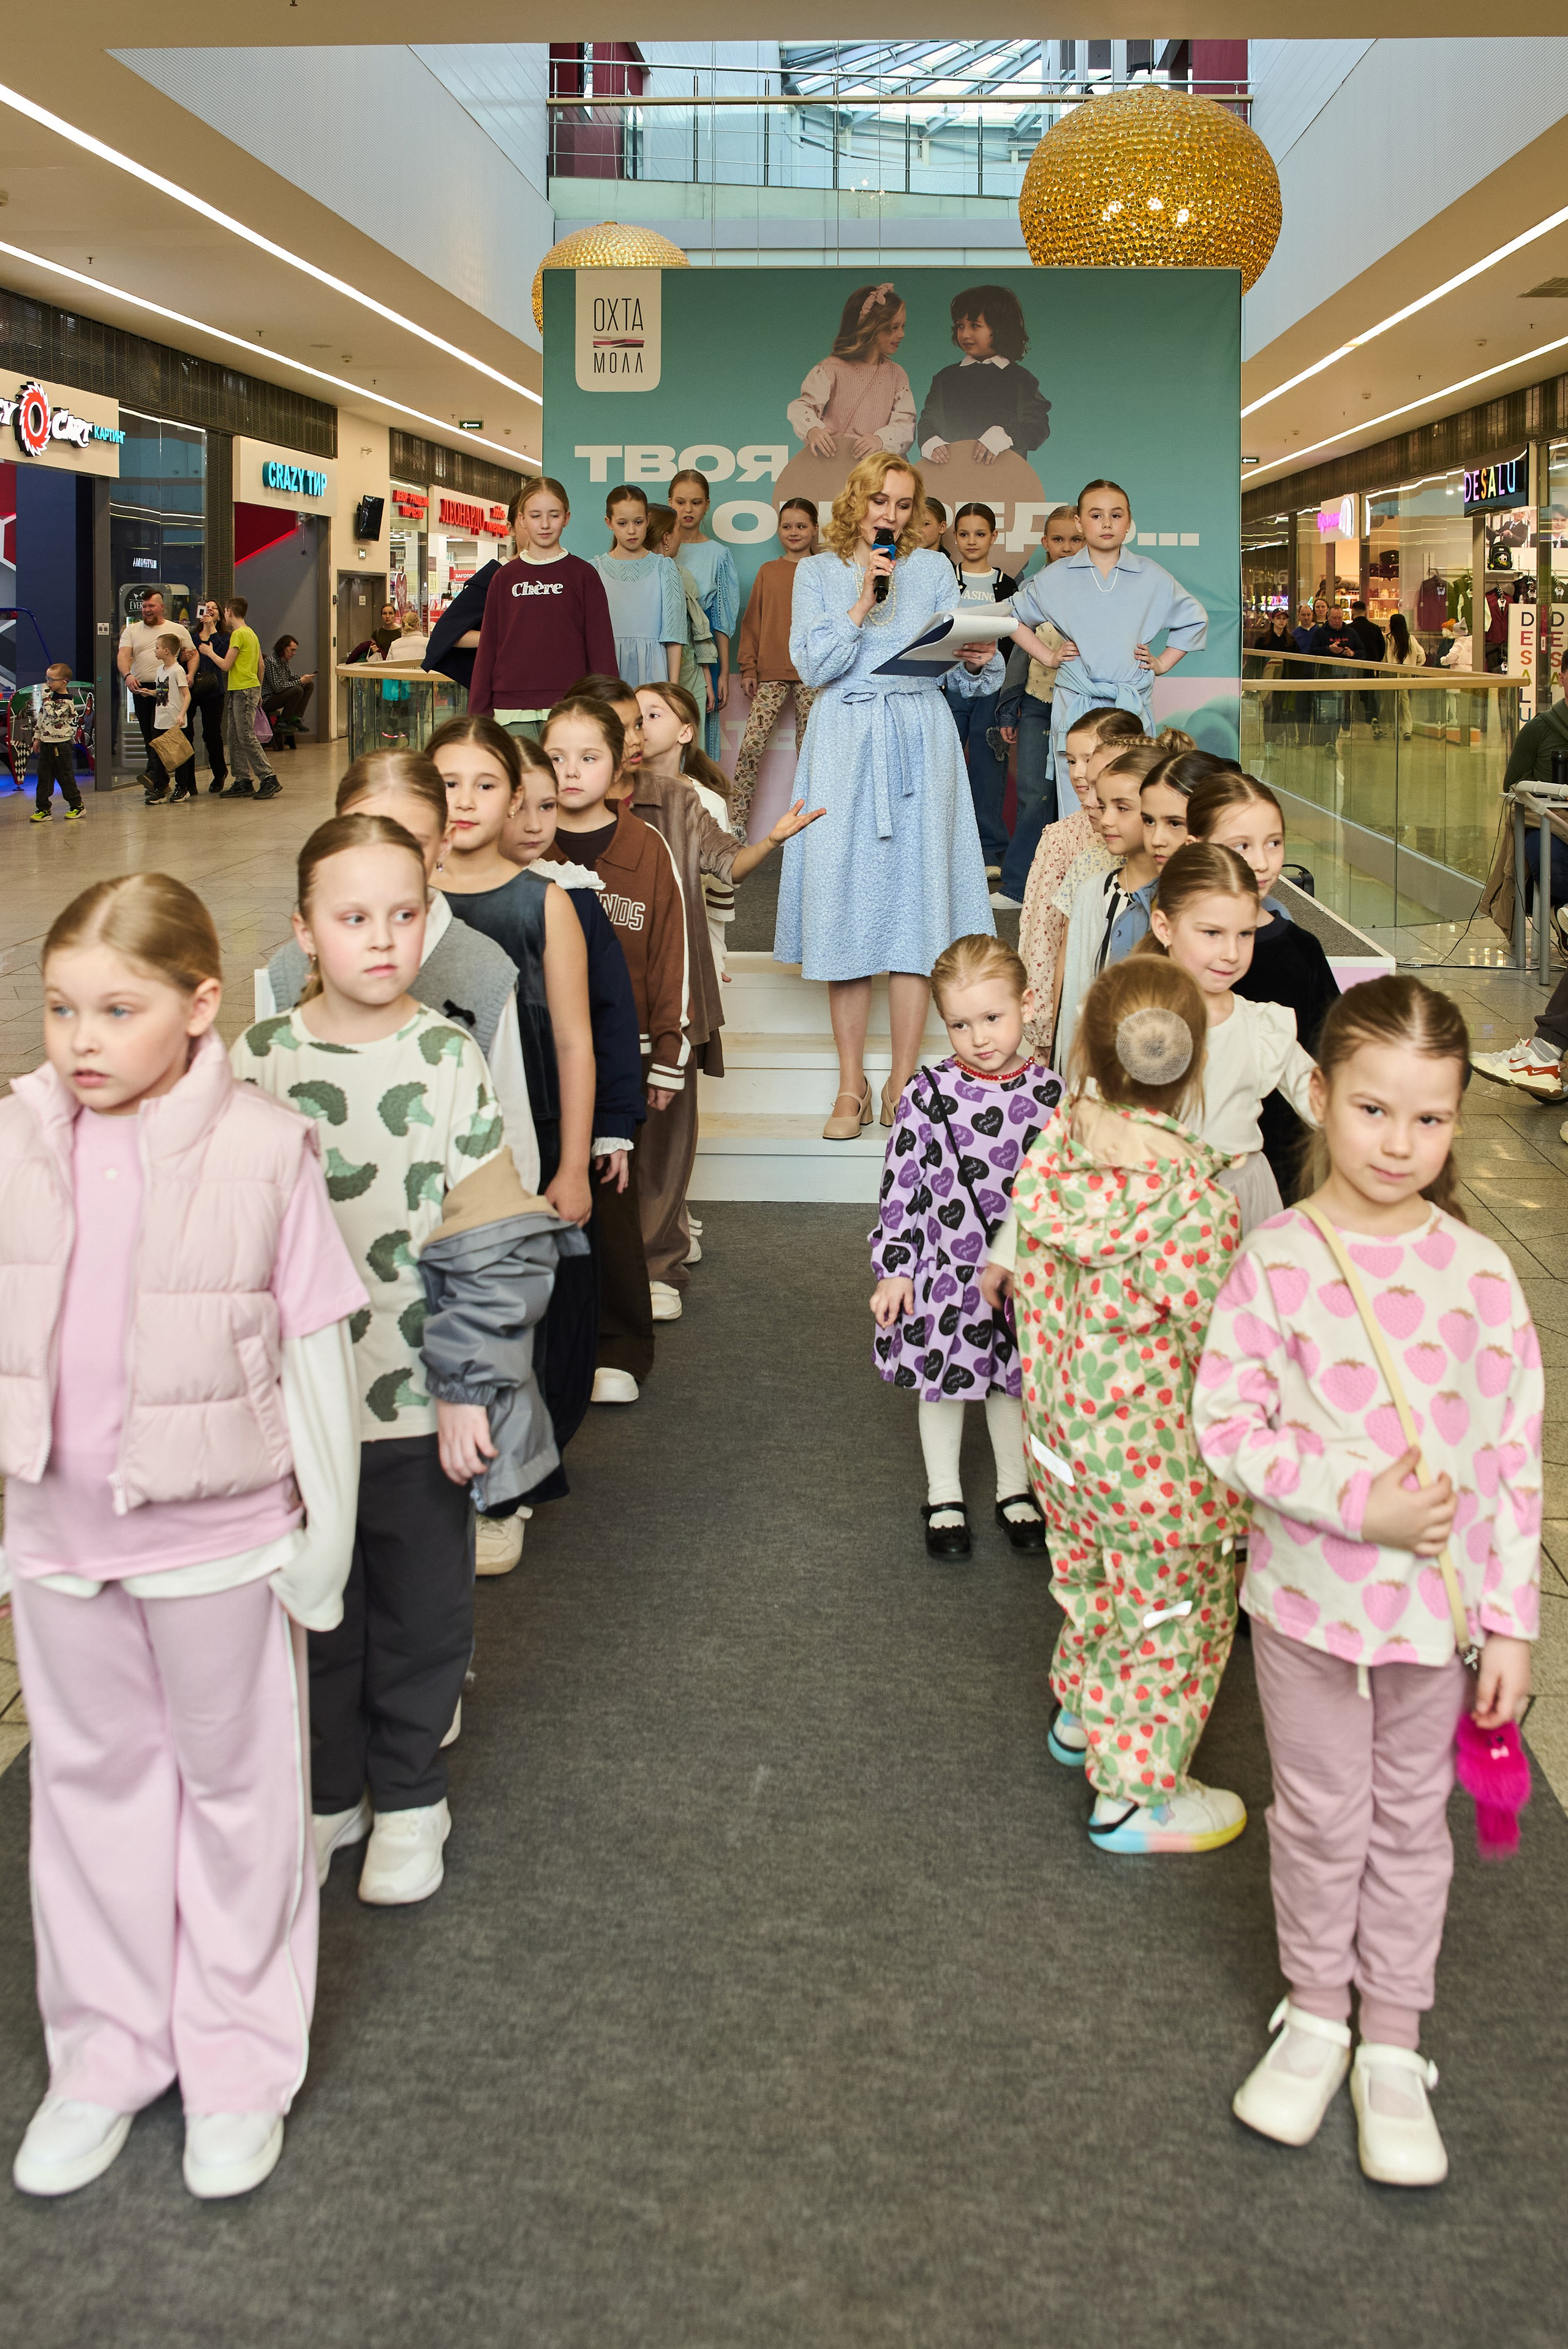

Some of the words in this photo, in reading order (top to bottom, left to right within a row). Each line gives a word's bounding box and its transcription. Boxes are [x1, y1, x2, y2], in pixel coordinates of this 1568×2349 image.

[594, 298, 643, 331] ОХТА
[594, 352, 643, 373] МОЛЛ
[94, 426, 126, 444] КАРТИНГ
[268, 461, 305, 492] CRAZY
[307, 470, 328, 497] ТИР
[575, 445, 789, 483] ТВОЯ
[1464, 461, 1515, 502] DESALU
[442, 499, 485, 530] ЛЕОНАРДО
[511, 580, 564, 597] Chère
[960, 591, 996, 602] ASING
[1519, 611, 1534, 722] DESALU
[595, 892, 646, 931] NDS
